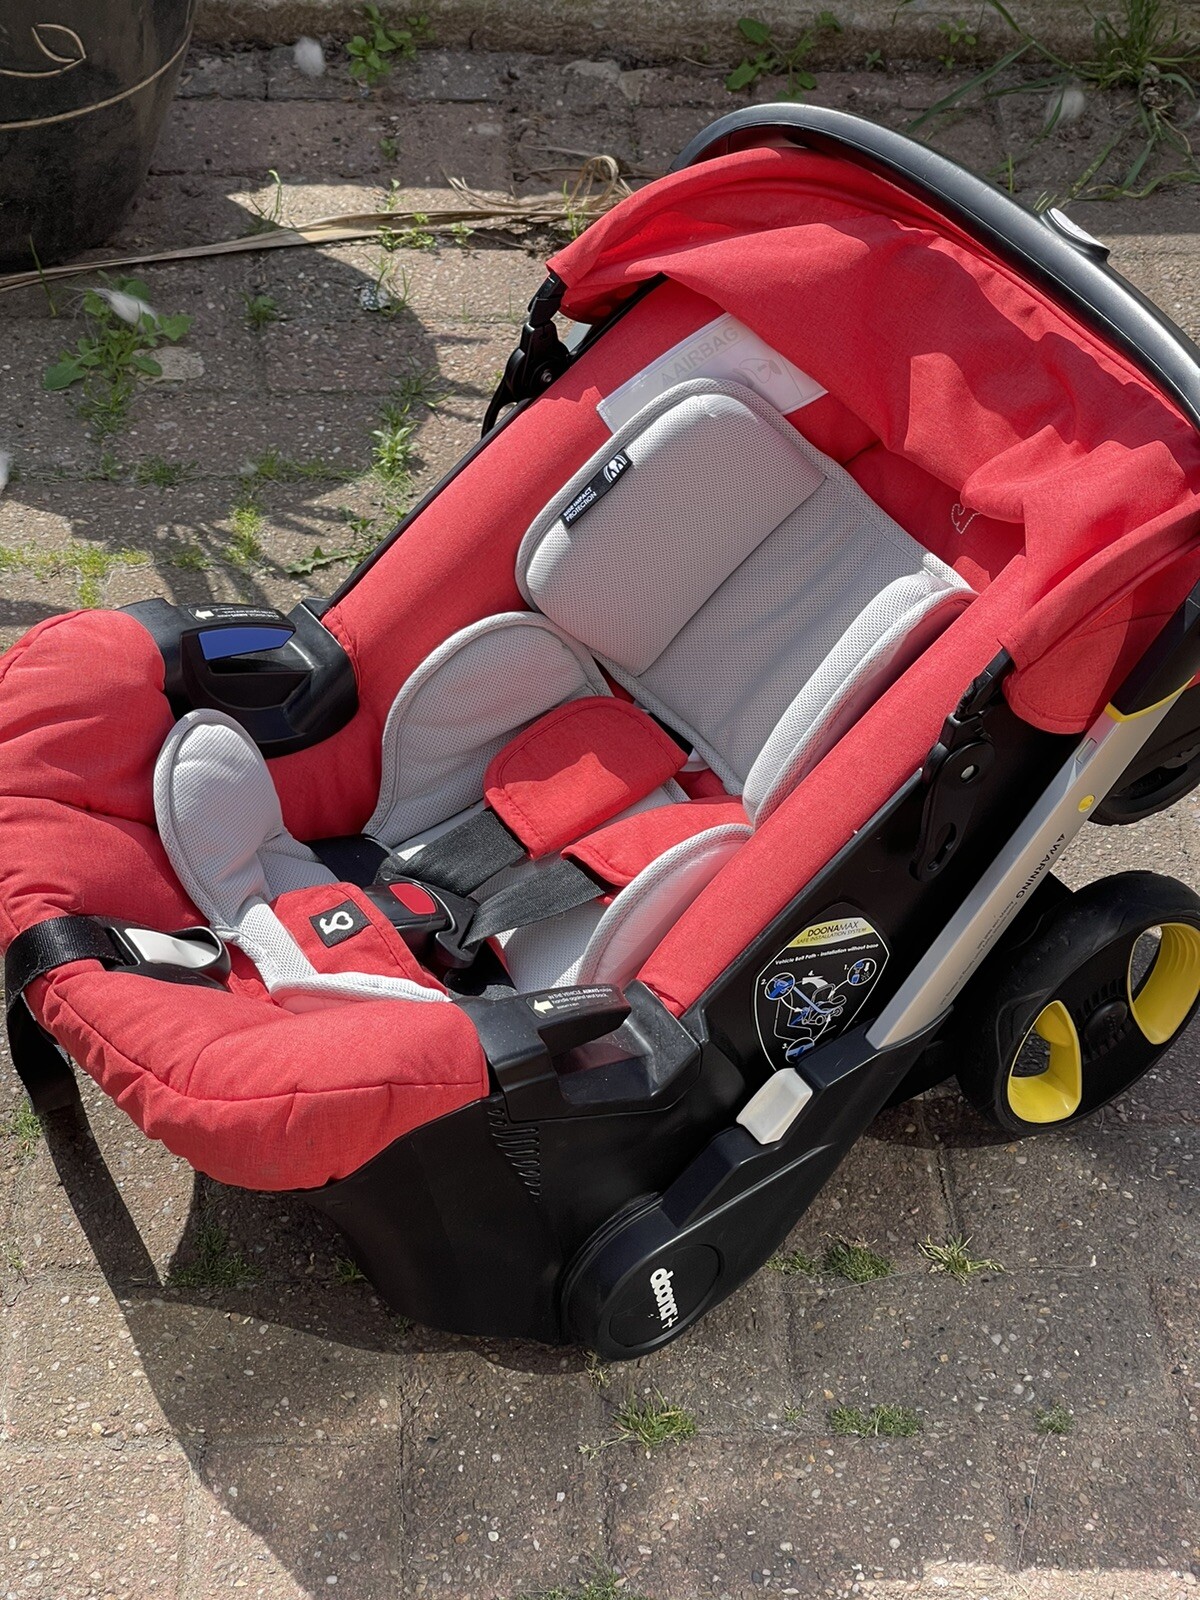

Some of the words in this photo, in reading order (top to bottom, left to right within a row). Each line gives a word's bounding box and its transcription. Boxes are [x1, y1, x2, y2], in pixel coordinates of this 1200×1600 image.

[673, 327, 738, 378] AIRBAG
[565, 491, 598, 522] PROTECTION
[573, 486, 592, 507] IMPACT
[1015, 843, 1061, 899] WARNING
[796, 937, 809, 945] SAFE
[809, 930, 847, 943] INSTALLATION
[846, 926, 867, 936] SYSTEM
[807, 920, 859, 938] DOONAMAX
[775, 957, 795, 966] Vehicle
[795, 954, 805, 962] Belt
[805, 952, 817, 960] Path
[847, 944, 866, 952] without
[865, 942, 879, 951] base
